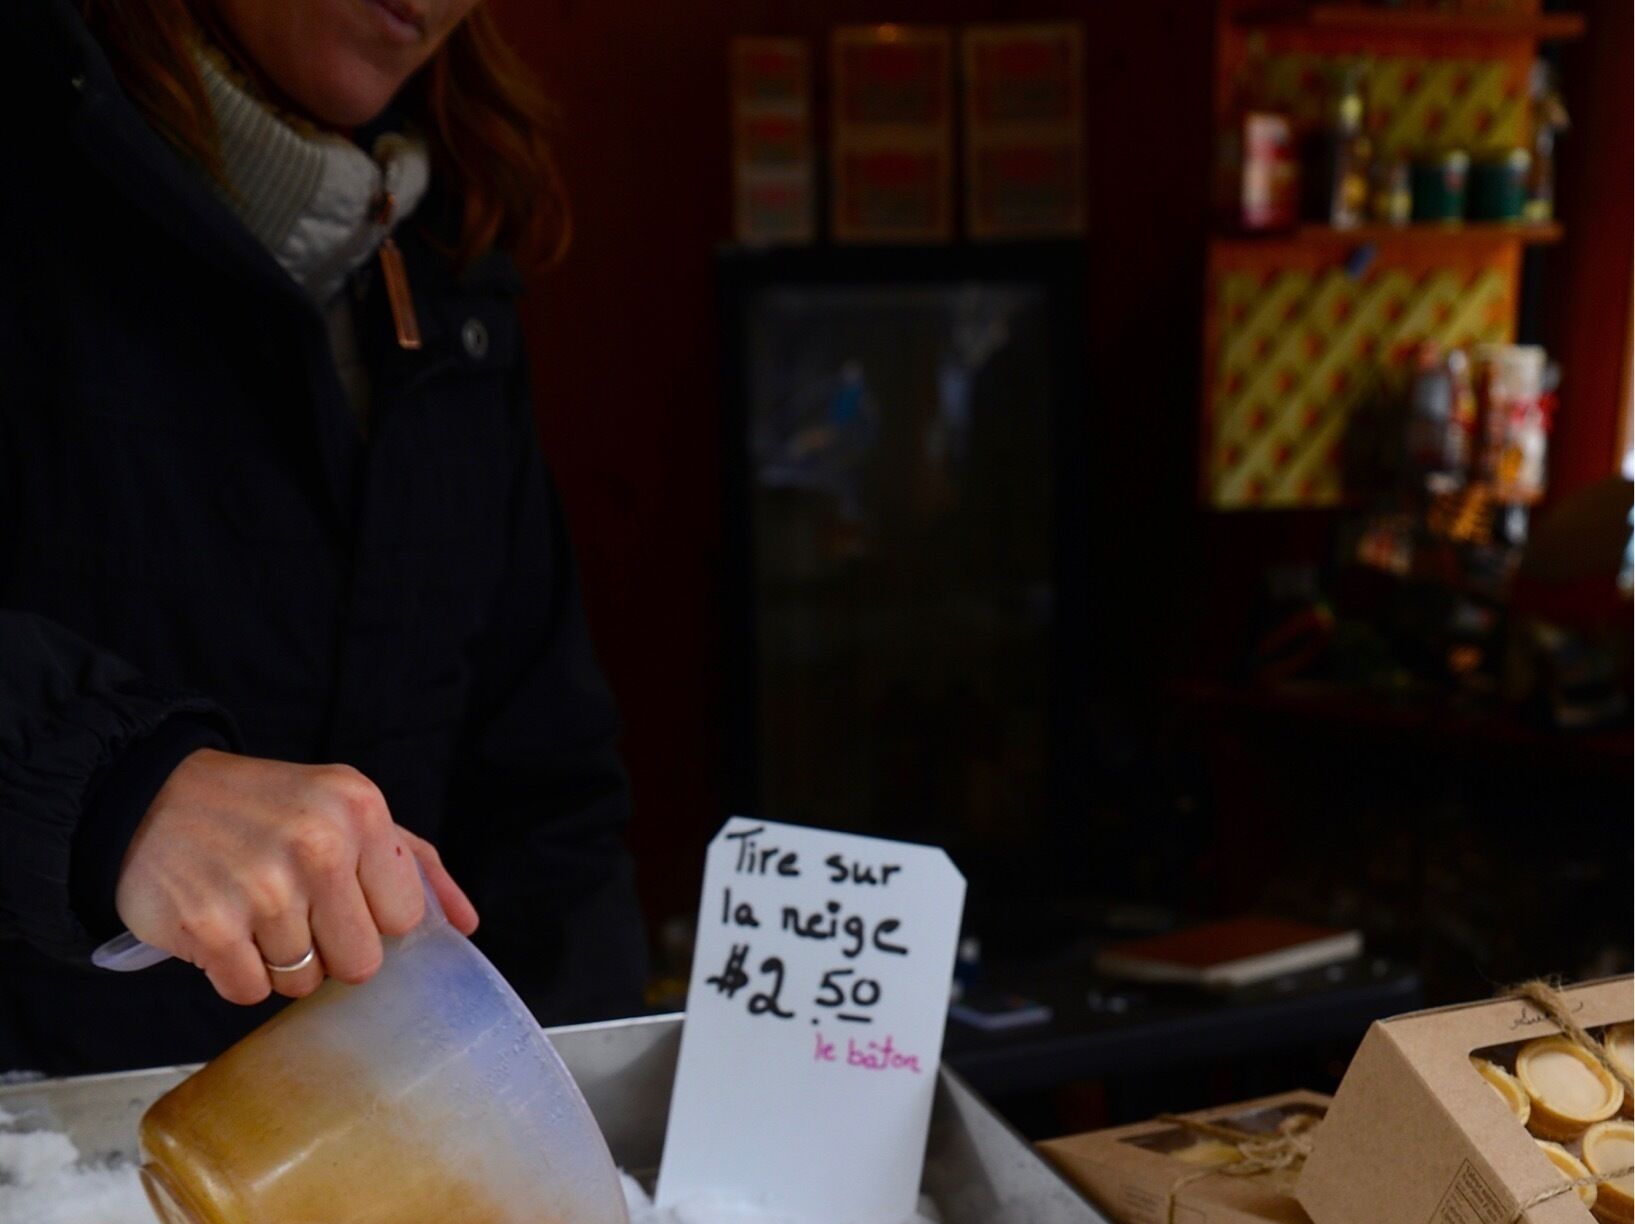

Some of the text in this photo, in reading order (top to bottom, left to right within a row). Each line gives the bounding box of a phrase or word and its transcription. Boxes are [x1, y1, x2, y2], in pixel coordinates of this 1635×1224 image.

[726, 826, 901, 885] Tire sur
[723, 887, 908, 958] la neige
[814, 1032, 921, 1074] le bâton
